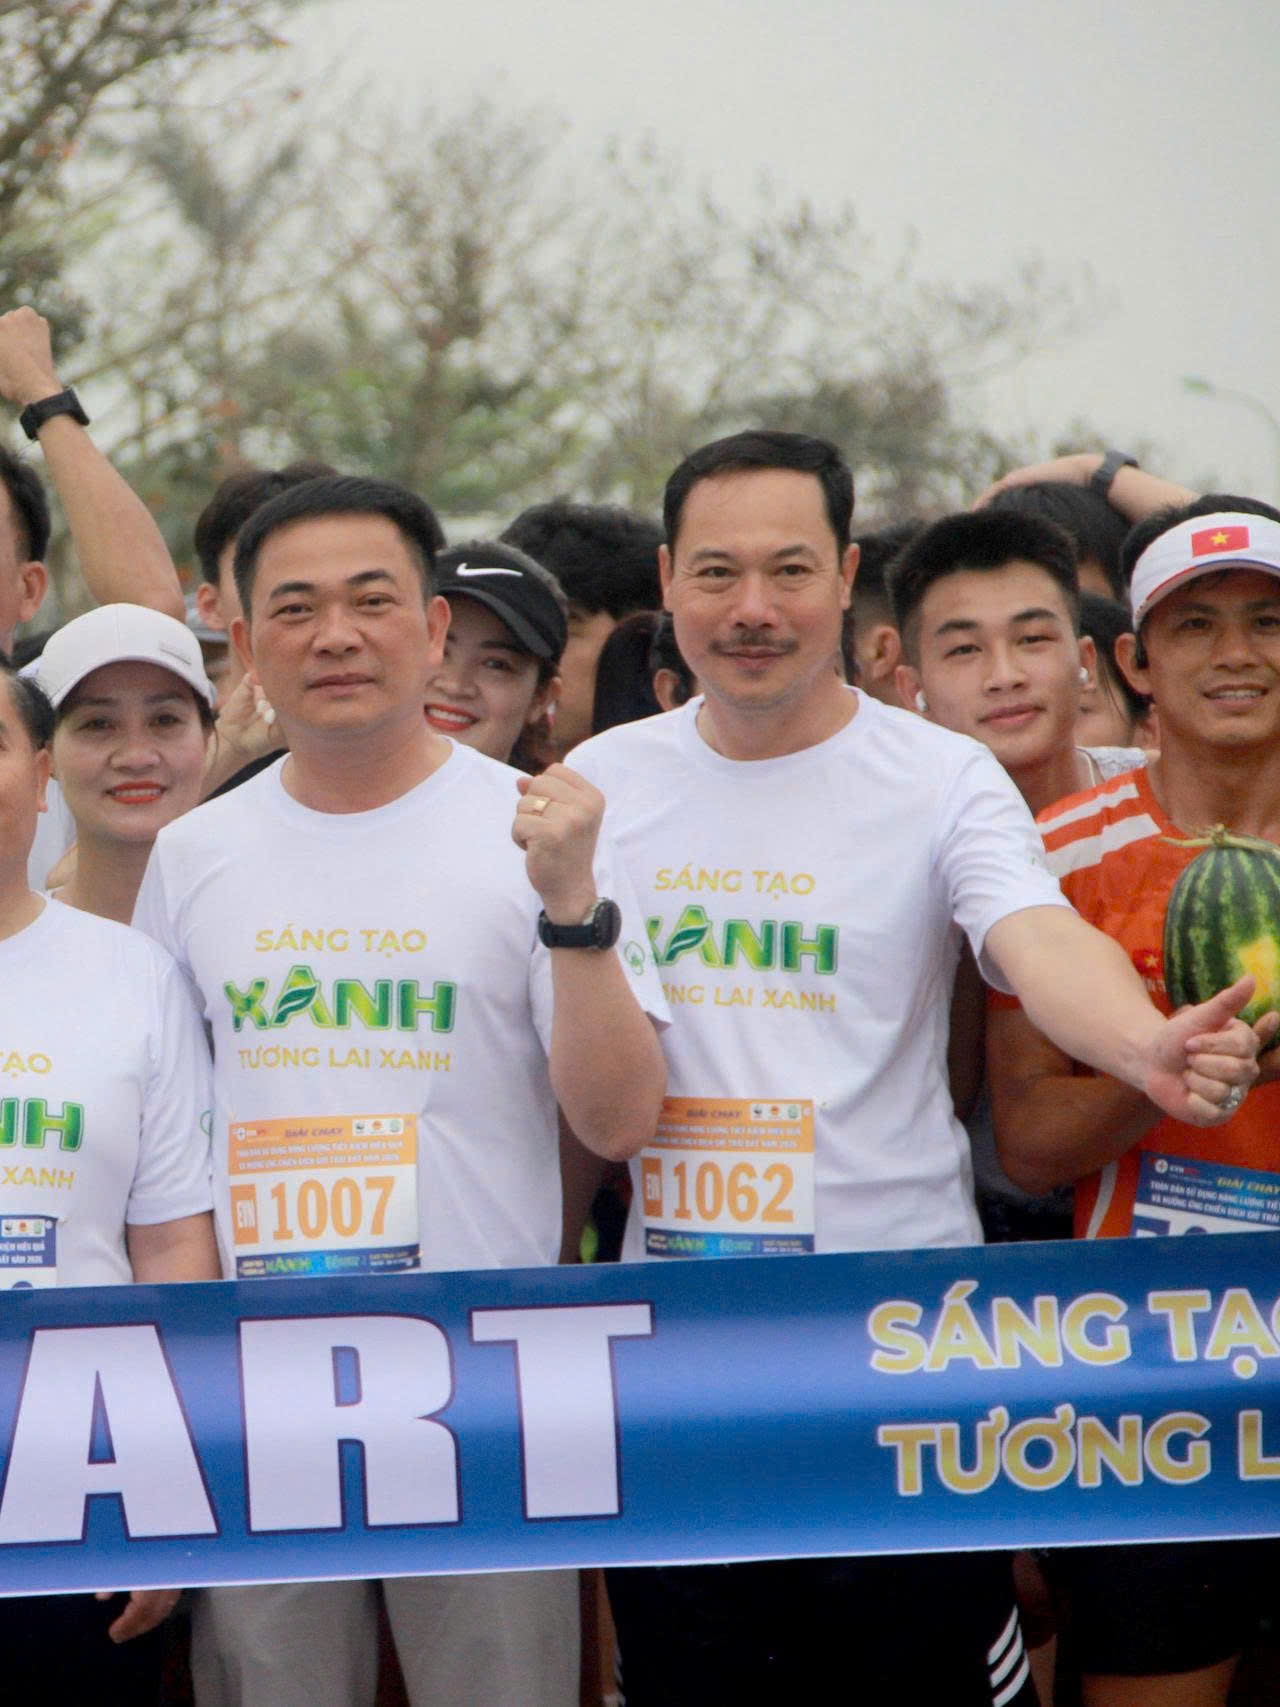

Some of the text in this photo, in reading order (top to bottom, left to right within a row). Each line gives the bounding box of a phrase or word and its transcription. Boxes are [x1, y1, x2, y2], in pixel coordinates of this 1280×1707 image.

[654, 863, 816, 901] SÁNG TẠO
[255, 923, 428, 958] SÁNG TẠO
[223, 965, 457, 1033] XANH
[714, 986, 755, 1008] LAI
[762, 987, 837, 1013] XANH
[238, 1044, 451, 1072] TƯƠNG LAI XANH
[1, 1165, 75, 1190] XANH
[673, 1160, 795, 1222] 1062
[271, 1176, 396, 1241] 1007
[867, 1280, 1280, 1380] SÁNG TẠ
[878, 1403, 1212, 1497] TƯƠNG
